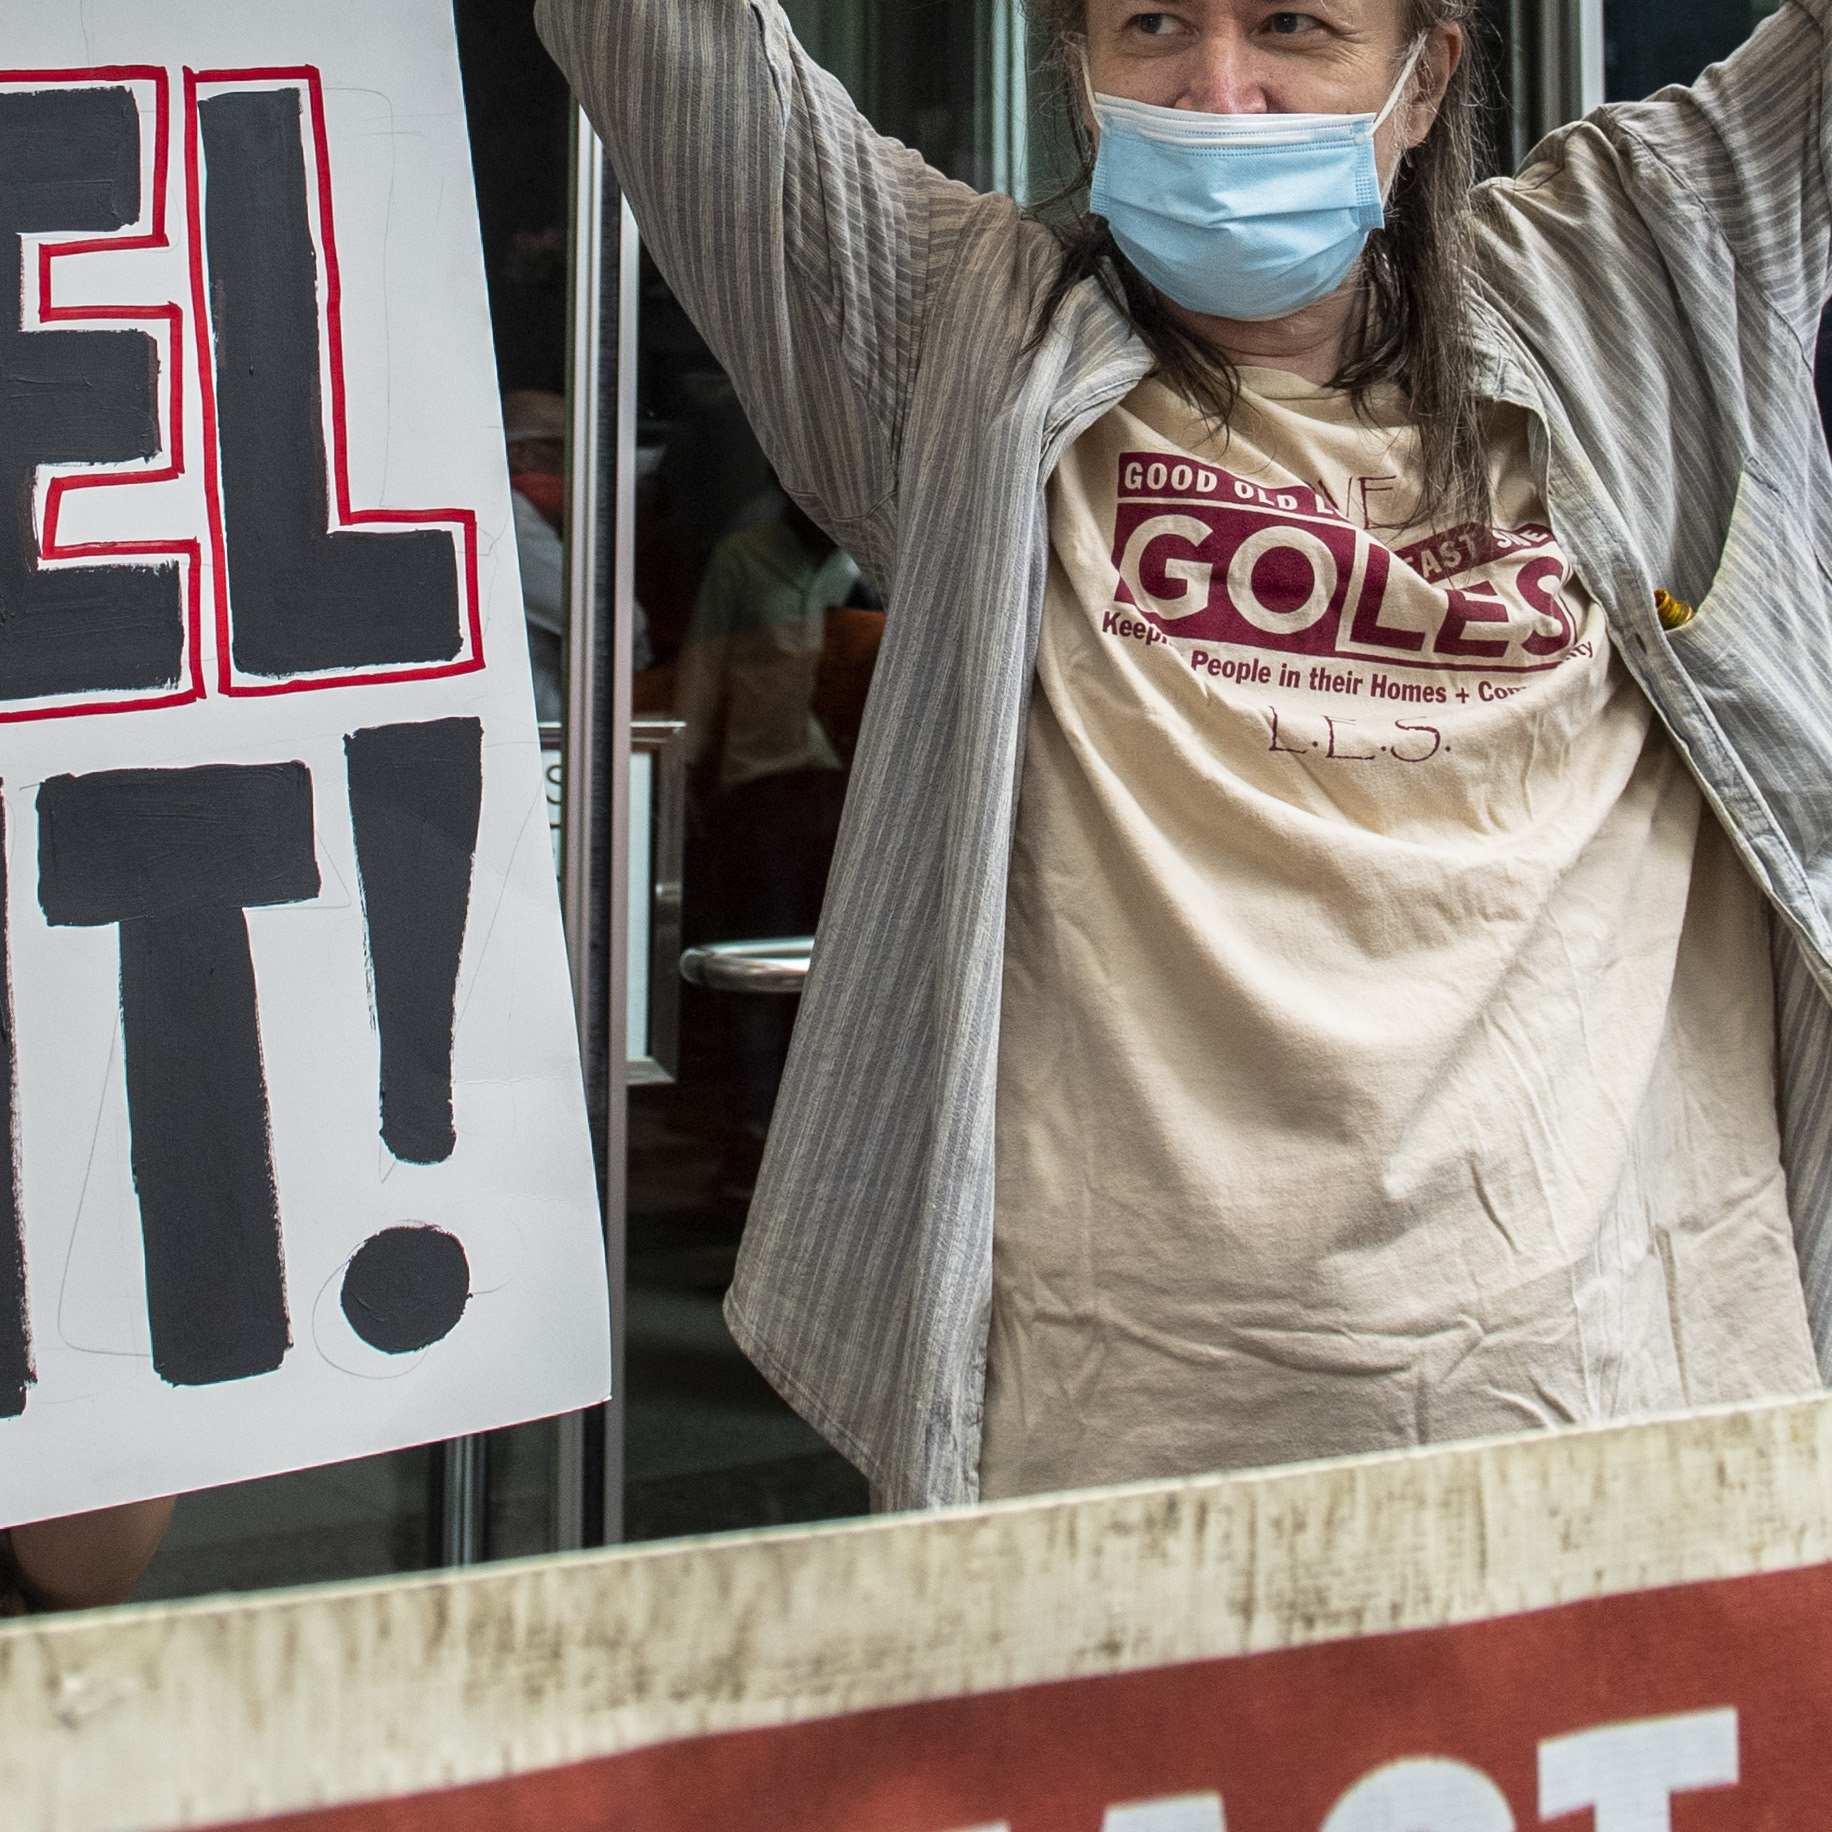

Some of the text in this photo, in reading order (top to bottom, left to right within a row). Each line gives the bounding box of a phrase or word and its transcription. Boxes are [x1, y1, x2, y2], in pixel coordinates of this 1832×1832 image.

[1124, 461, 1218, 493] GOOD
[1233, 479, 1298, 511] OLD
[1403, 533, 1478, 579] AST
[1119, 513, 1571, 659] GOLES
[1190, 649, 1272, 685] People
[1278, 662, 1301, 689] in
[1309, 666, 1364, 696] their
[1370, 673, 1448, 704] Homes
[1268, 705, 1452, 763] L.E.S.
